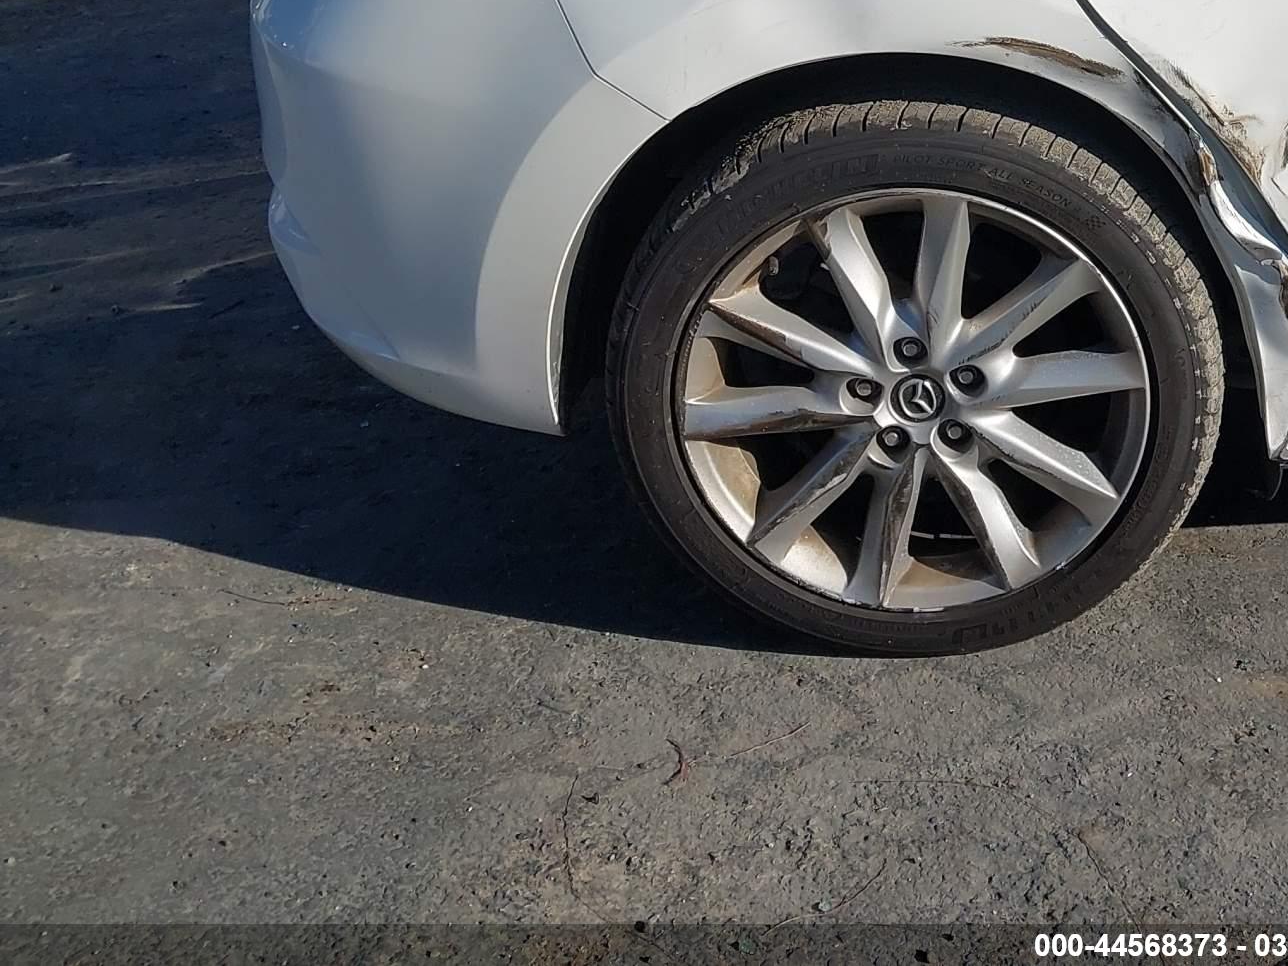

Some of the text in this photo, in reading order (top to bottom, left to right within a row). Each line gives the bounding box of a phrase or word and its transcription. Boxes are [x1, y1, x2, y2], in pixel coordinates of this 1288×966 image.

[937, 156, 987, 171] SPORT
[988, 167, 1014, 180] ALL
[1021, 177, 1072, 208] SEASON
